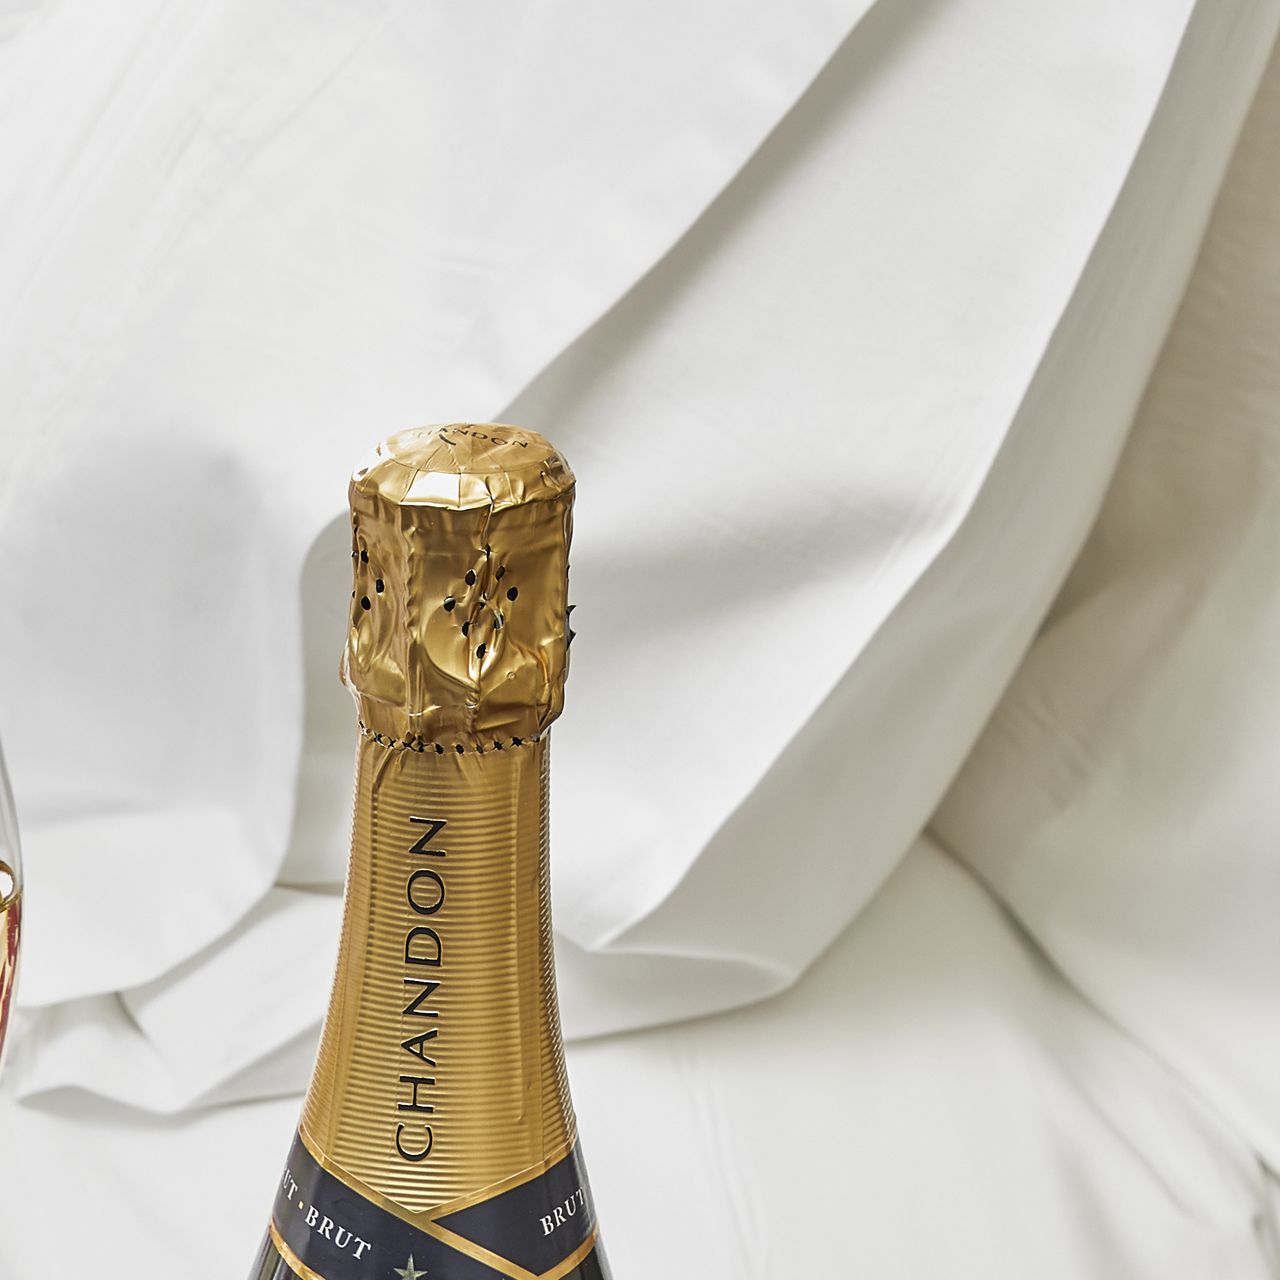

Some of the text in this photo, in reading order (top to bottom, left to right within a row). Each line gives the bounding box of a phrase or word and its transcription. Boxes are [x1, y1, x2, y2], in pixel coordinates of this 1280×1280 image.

[395, 815, 448, 1162] CHANDON
[305, 1205, 372, 1259] BRUT
[539, 1186, 585, 1236] BRUT
